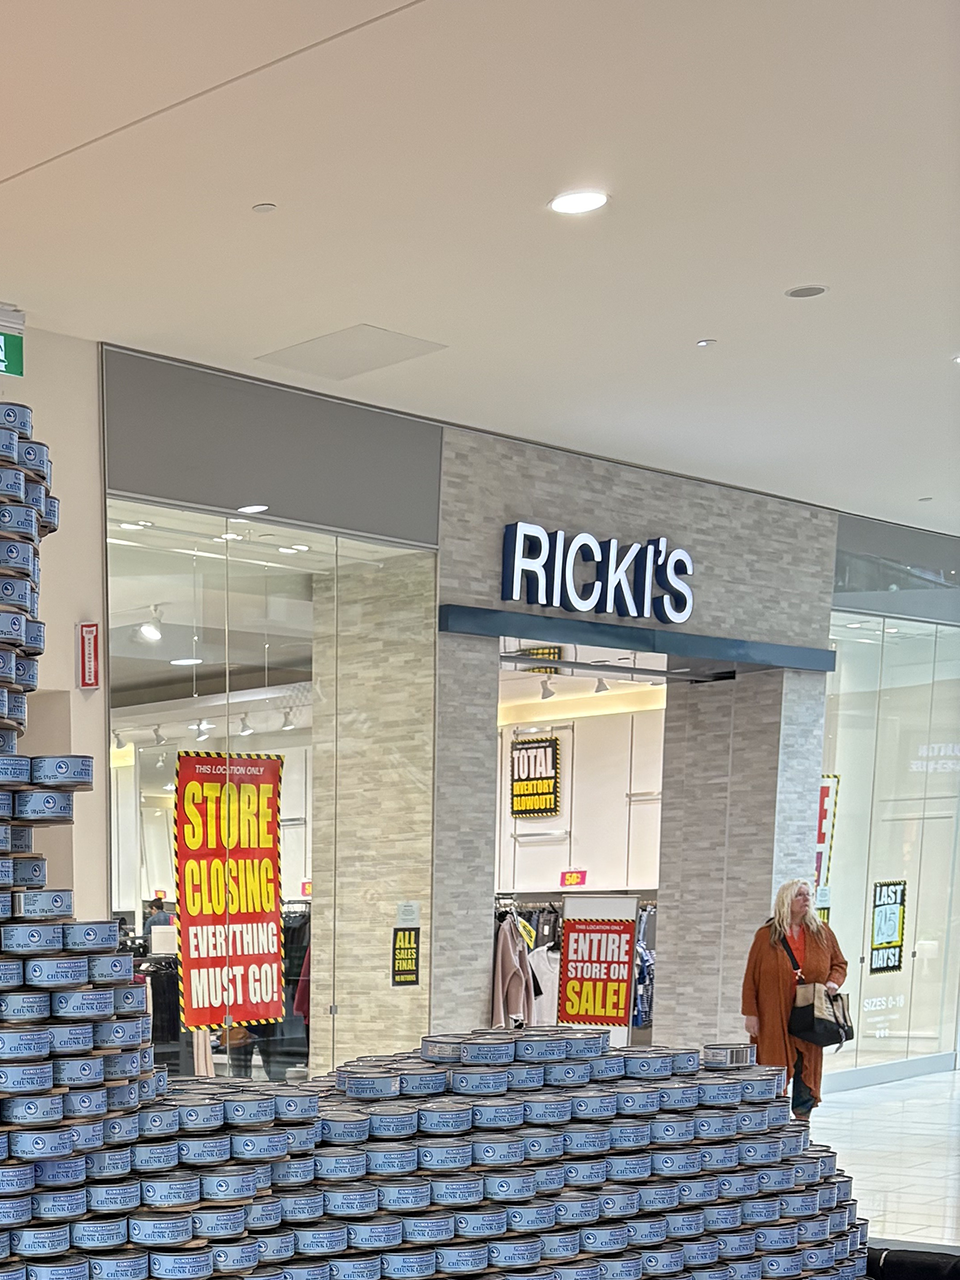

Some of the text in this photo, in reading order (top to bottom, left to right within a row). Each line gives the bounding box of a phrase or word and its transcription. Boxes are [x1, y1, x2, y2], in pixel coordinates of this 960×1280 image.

[509, 521, 694, 624] RICKI'S
[195, 764, 212, 774] THIS
[246, 766, 265, 775] ONLY
[512, 748, 555, 780] TOTAL
[513, 779, 554, 796] INVENTORY
[513, 794, 554, 811] BLOWOUT!
[183, 780, 274, 850] STORE
[184, 857, 276, 917] CLOSING
[875, 884, 904, 906] LAST
[188, 921, 278, 958] EVERYTHING
[395, 931, 417, 949] ALL
[568, 932, 630, 962] ENTIRE
[395, 949, 417, 959] SALES
[395, 959, 416, 971] FINAL
[872, 947, 900, 969] DAYS!
[567, 962, 629, 980] STORE ON
[190, 963, 278, 1009] MUST GO!
[565, 979, 628, 1018] SALE!
[863, 996, 887, 1012] SIZES
[75, 1233, 115, 1242] CHUNK LIGHT
